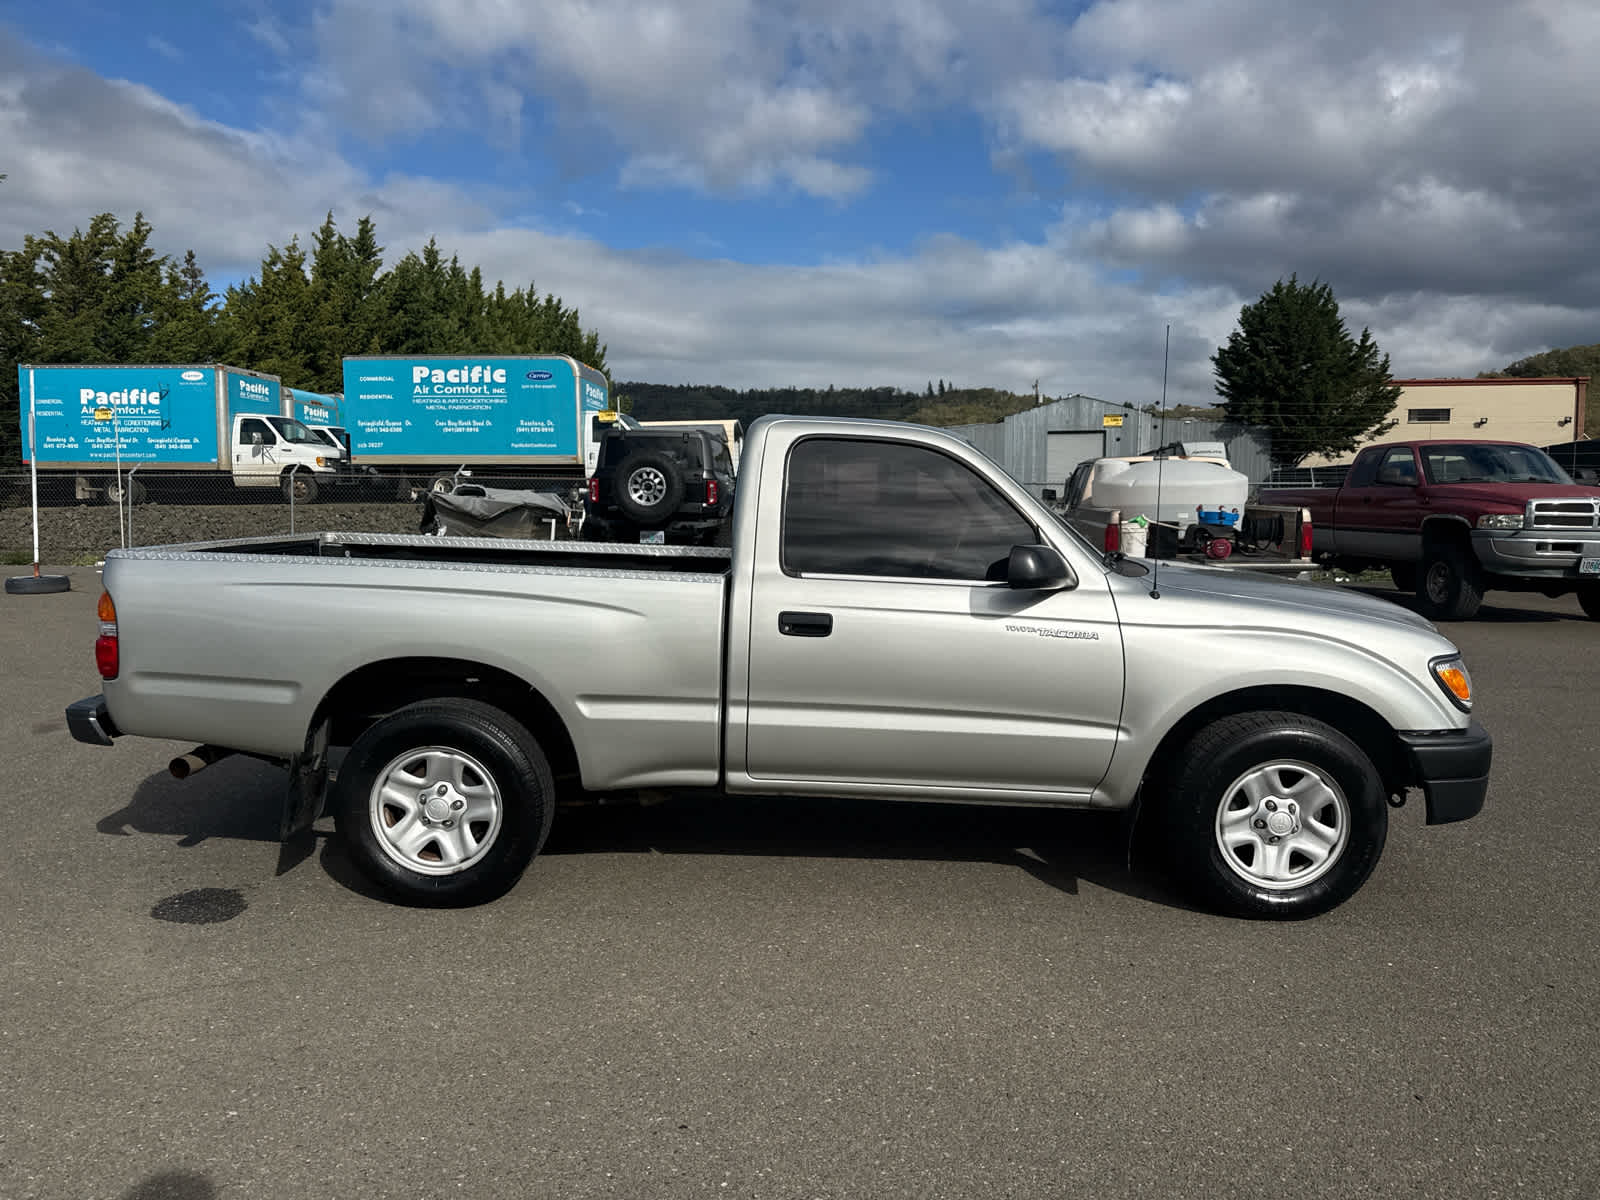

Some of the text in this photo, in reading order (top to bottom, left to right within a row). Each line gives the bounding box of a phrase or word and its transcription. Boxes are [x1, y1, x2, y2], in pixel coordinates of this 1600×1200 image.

[412, 365, 507, 384] Pacific
[239, 379, 270, 396] Pacific
[413, 385, 429, 394] Air
[433, 385, 489, 395] Comfort,
[80, 388, 161, 405] Pacific
[81, 405, 95, 414] Air
[98, 405, 147, 415] mfort,
[303, 405, 329, 419] Pacific
[1038, 628, 1100, 641] TACOMA
